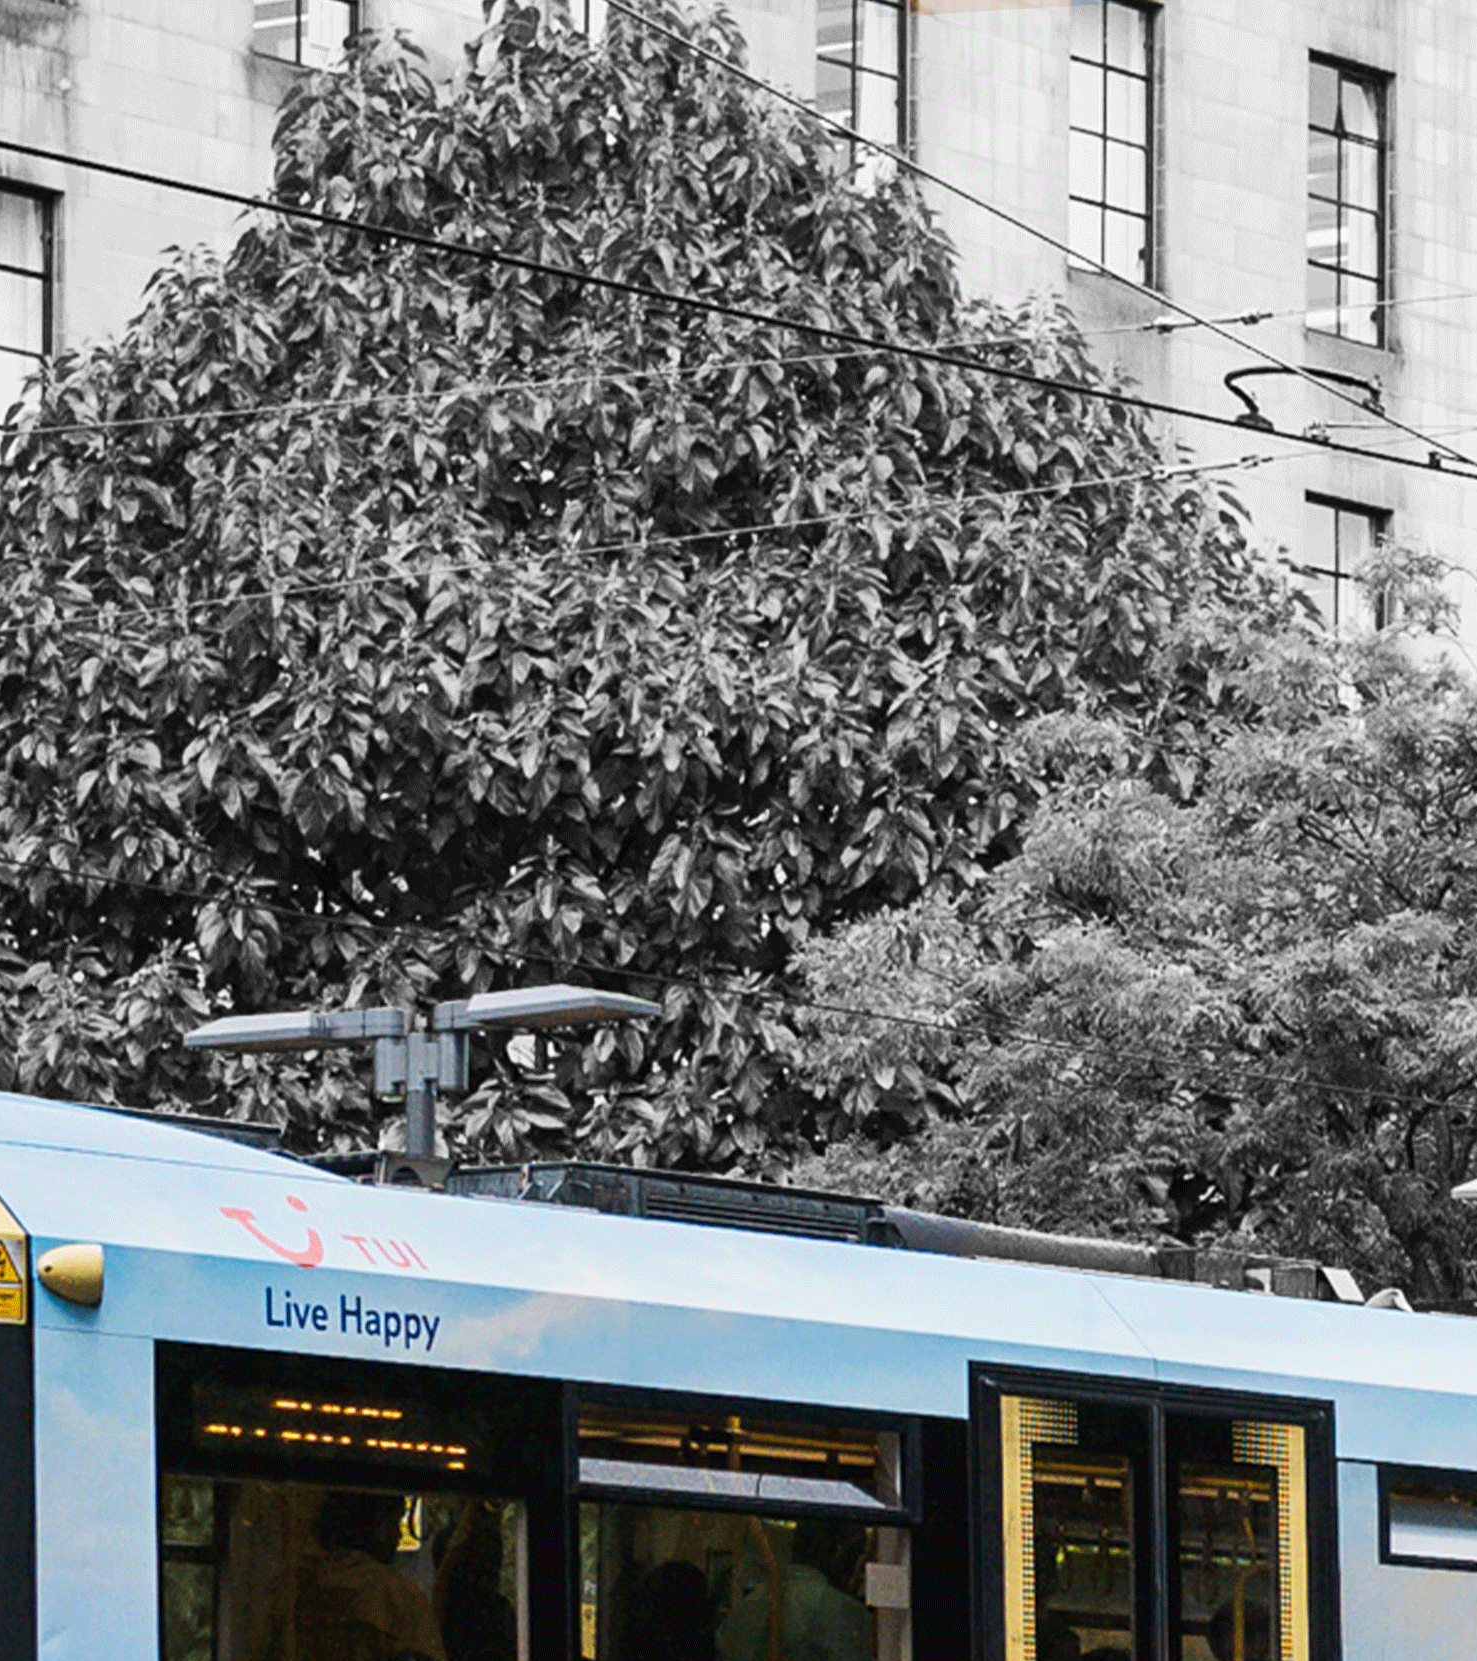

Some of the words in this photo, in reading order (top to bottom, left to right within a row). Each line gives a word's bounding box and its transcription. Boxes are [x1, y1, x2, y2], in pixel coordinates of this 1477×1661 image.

[340, 1233, 429, 1271] TUI
[265, 1285, 329, 1331] Live
[339, 1293, 441, 1352] Happy
